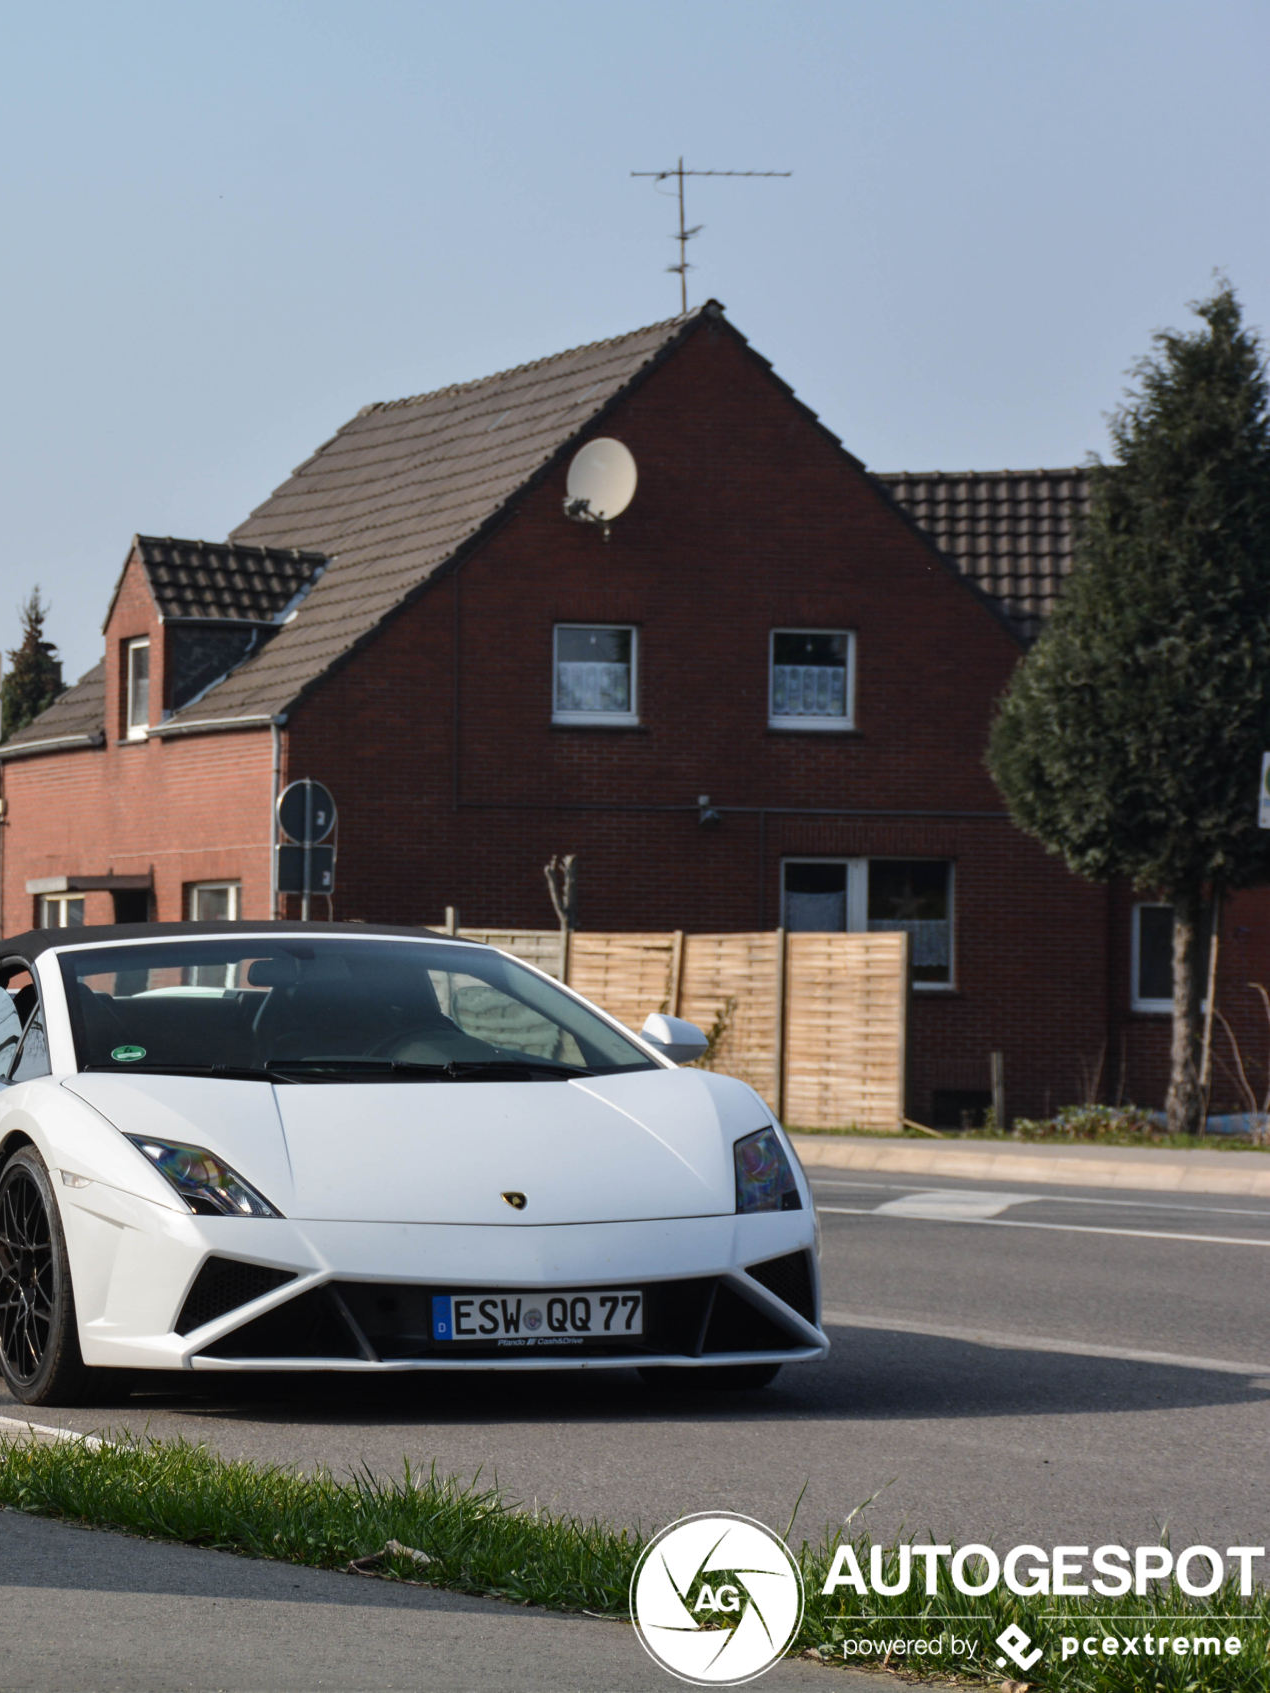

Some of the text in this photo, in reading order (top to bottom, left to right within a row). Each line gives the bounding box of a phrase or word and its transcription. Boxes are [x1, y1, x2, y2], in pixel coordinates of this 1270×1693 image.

[454, 1295, 641, 1335] ESW QQ 77
[438, 1323, 446, 1332] D
